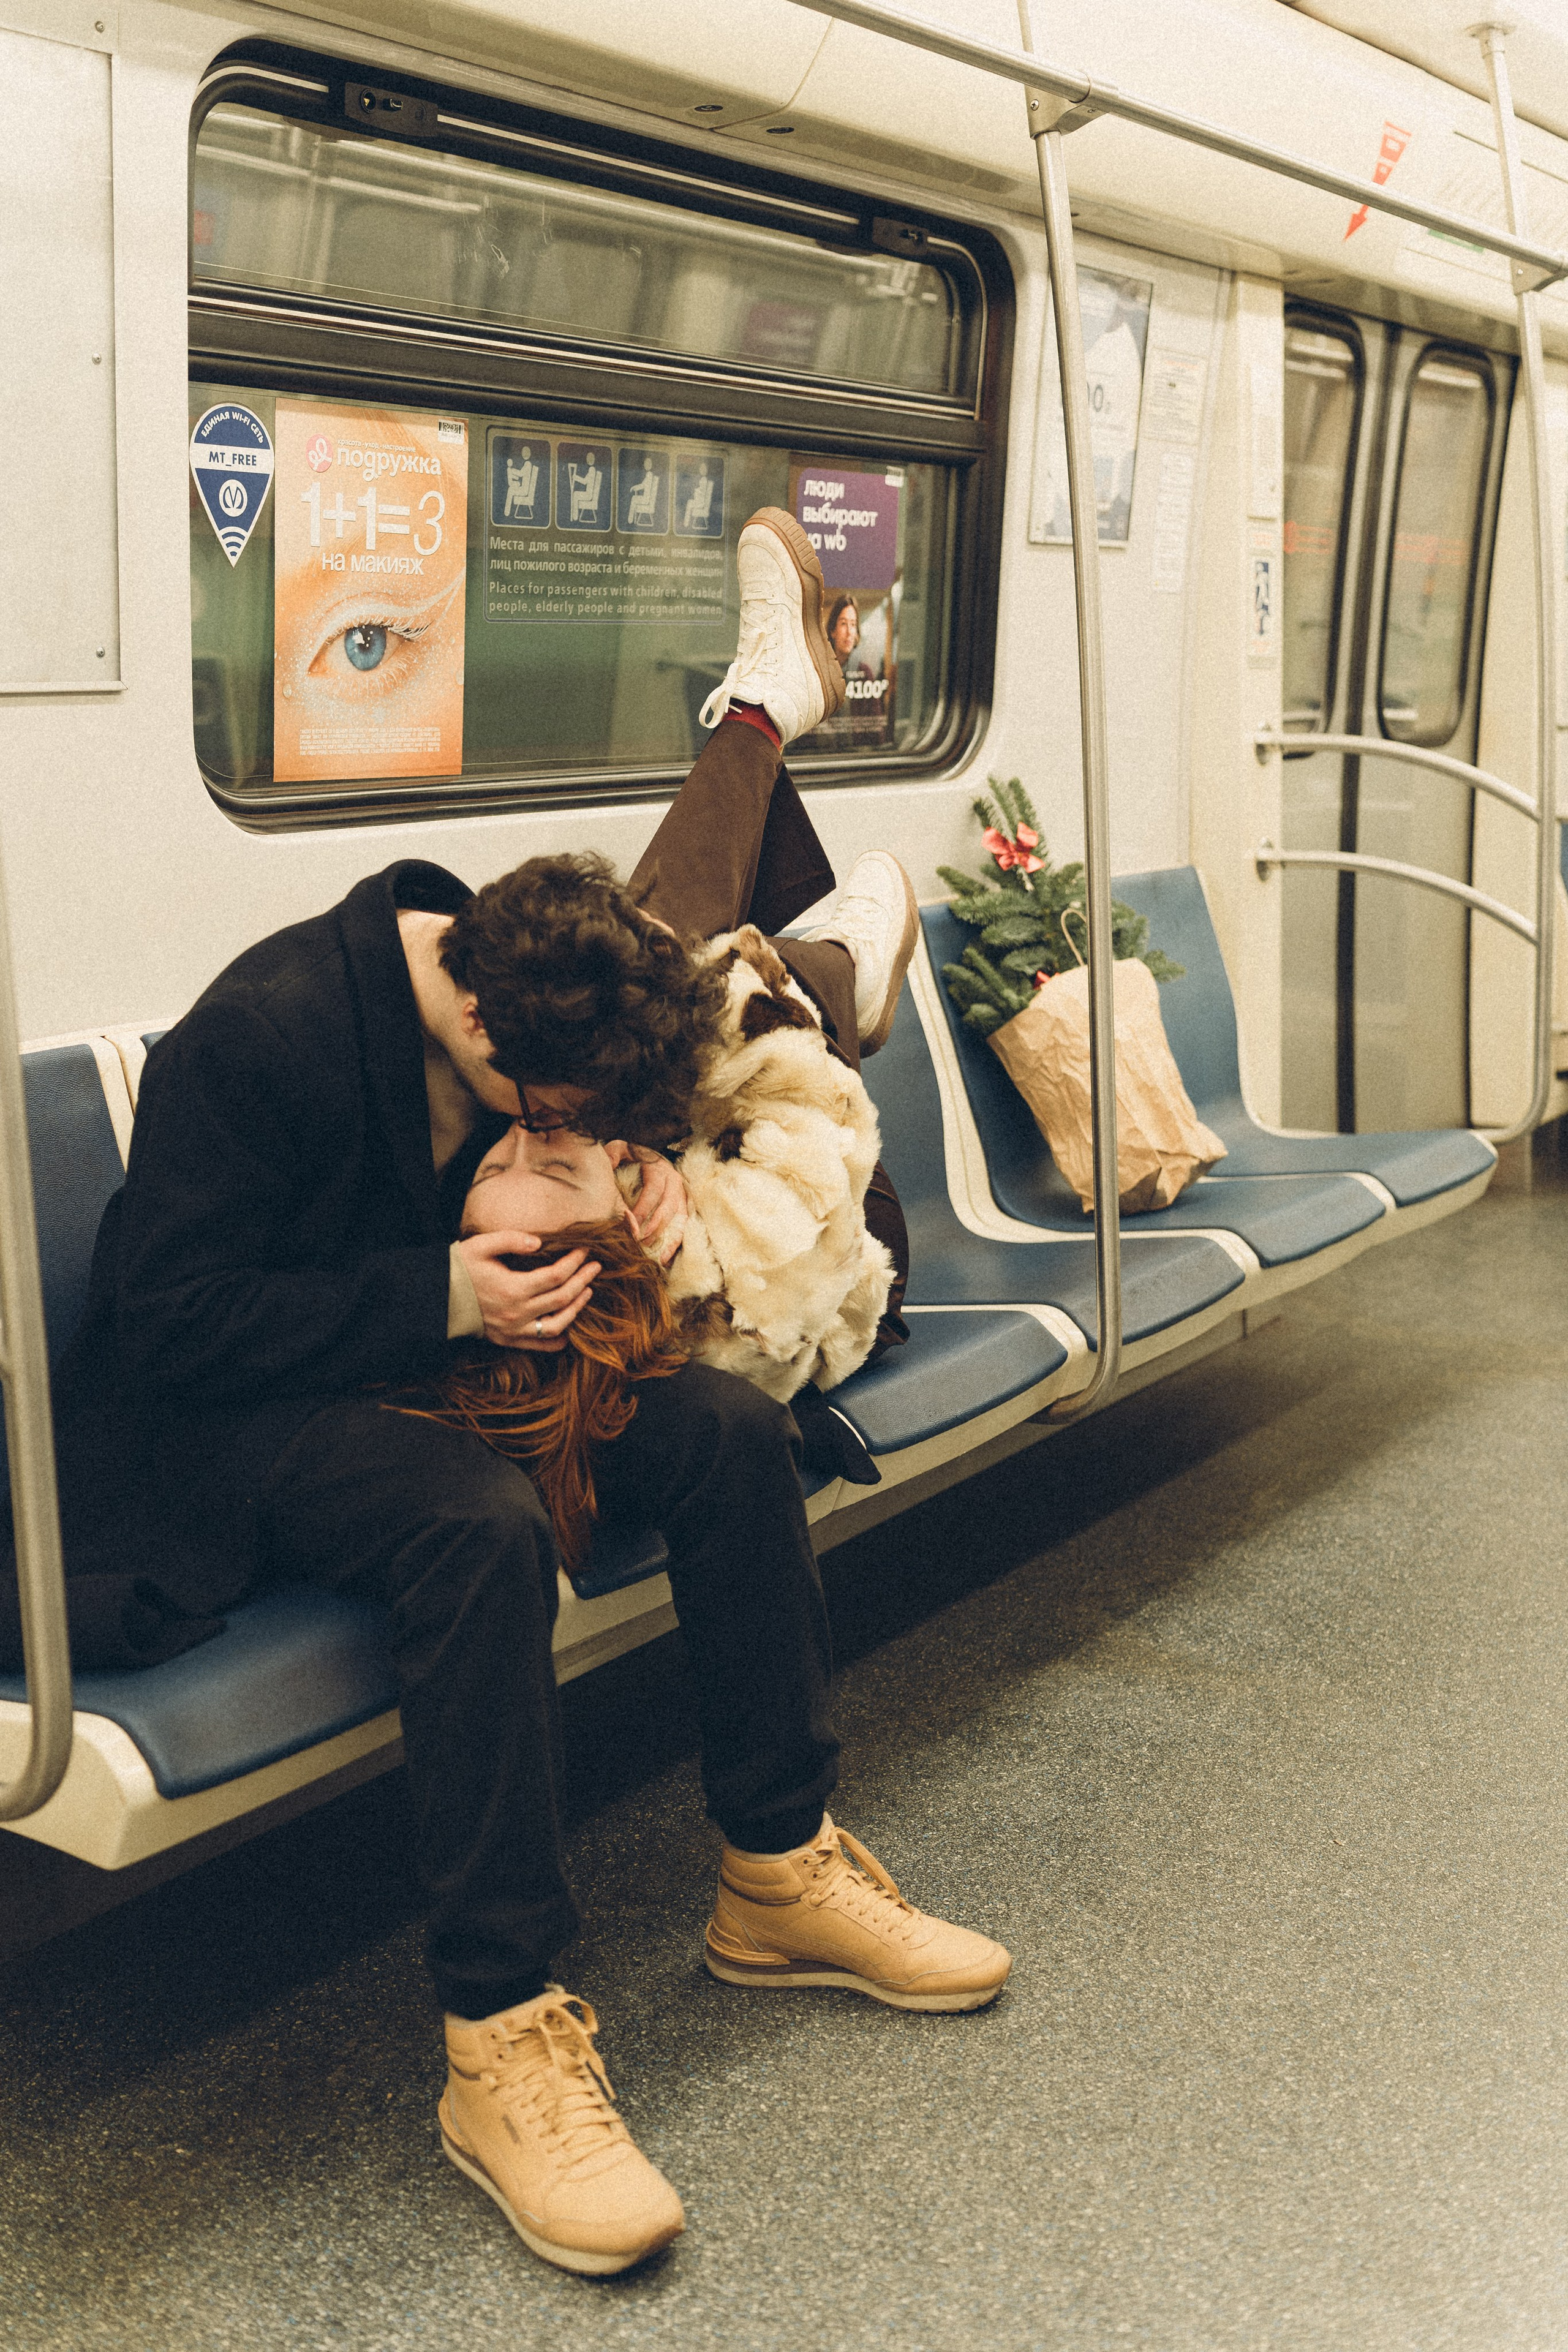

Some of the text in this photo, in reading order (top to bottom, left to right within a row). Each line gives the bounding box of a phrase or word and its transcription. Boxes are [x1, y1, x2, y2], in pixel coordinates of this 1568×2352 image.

[201, 412, 264, 443] ЕДИНАЯ WI-FI СЕТЬ
[337, 439, 361, 447] красота
[382, 444, 416, 453] настроение
[209, 451, 257, 467] MT_FREE
[337, 447, 442, 481] подружка
[804, 480, 845, 501] люди
[802, 502, 878, 528] выбирают
[490, 537, 524, 551] Места
[529, 541, 549, 553] для
[554, 543, 614, 557] пассажиров
[619, 545, 625, 555] с
[628, 546, 666, 558] детьми,
[322, 552, 424, 575] на макияж
[490, 560, 722, 578] лиц пожилого возраста и беременных женщин
[490, 582, 723, 599] Places for passengers with children, disabled
[489, 600, 722, 616] people, elderly people and pregnant women
